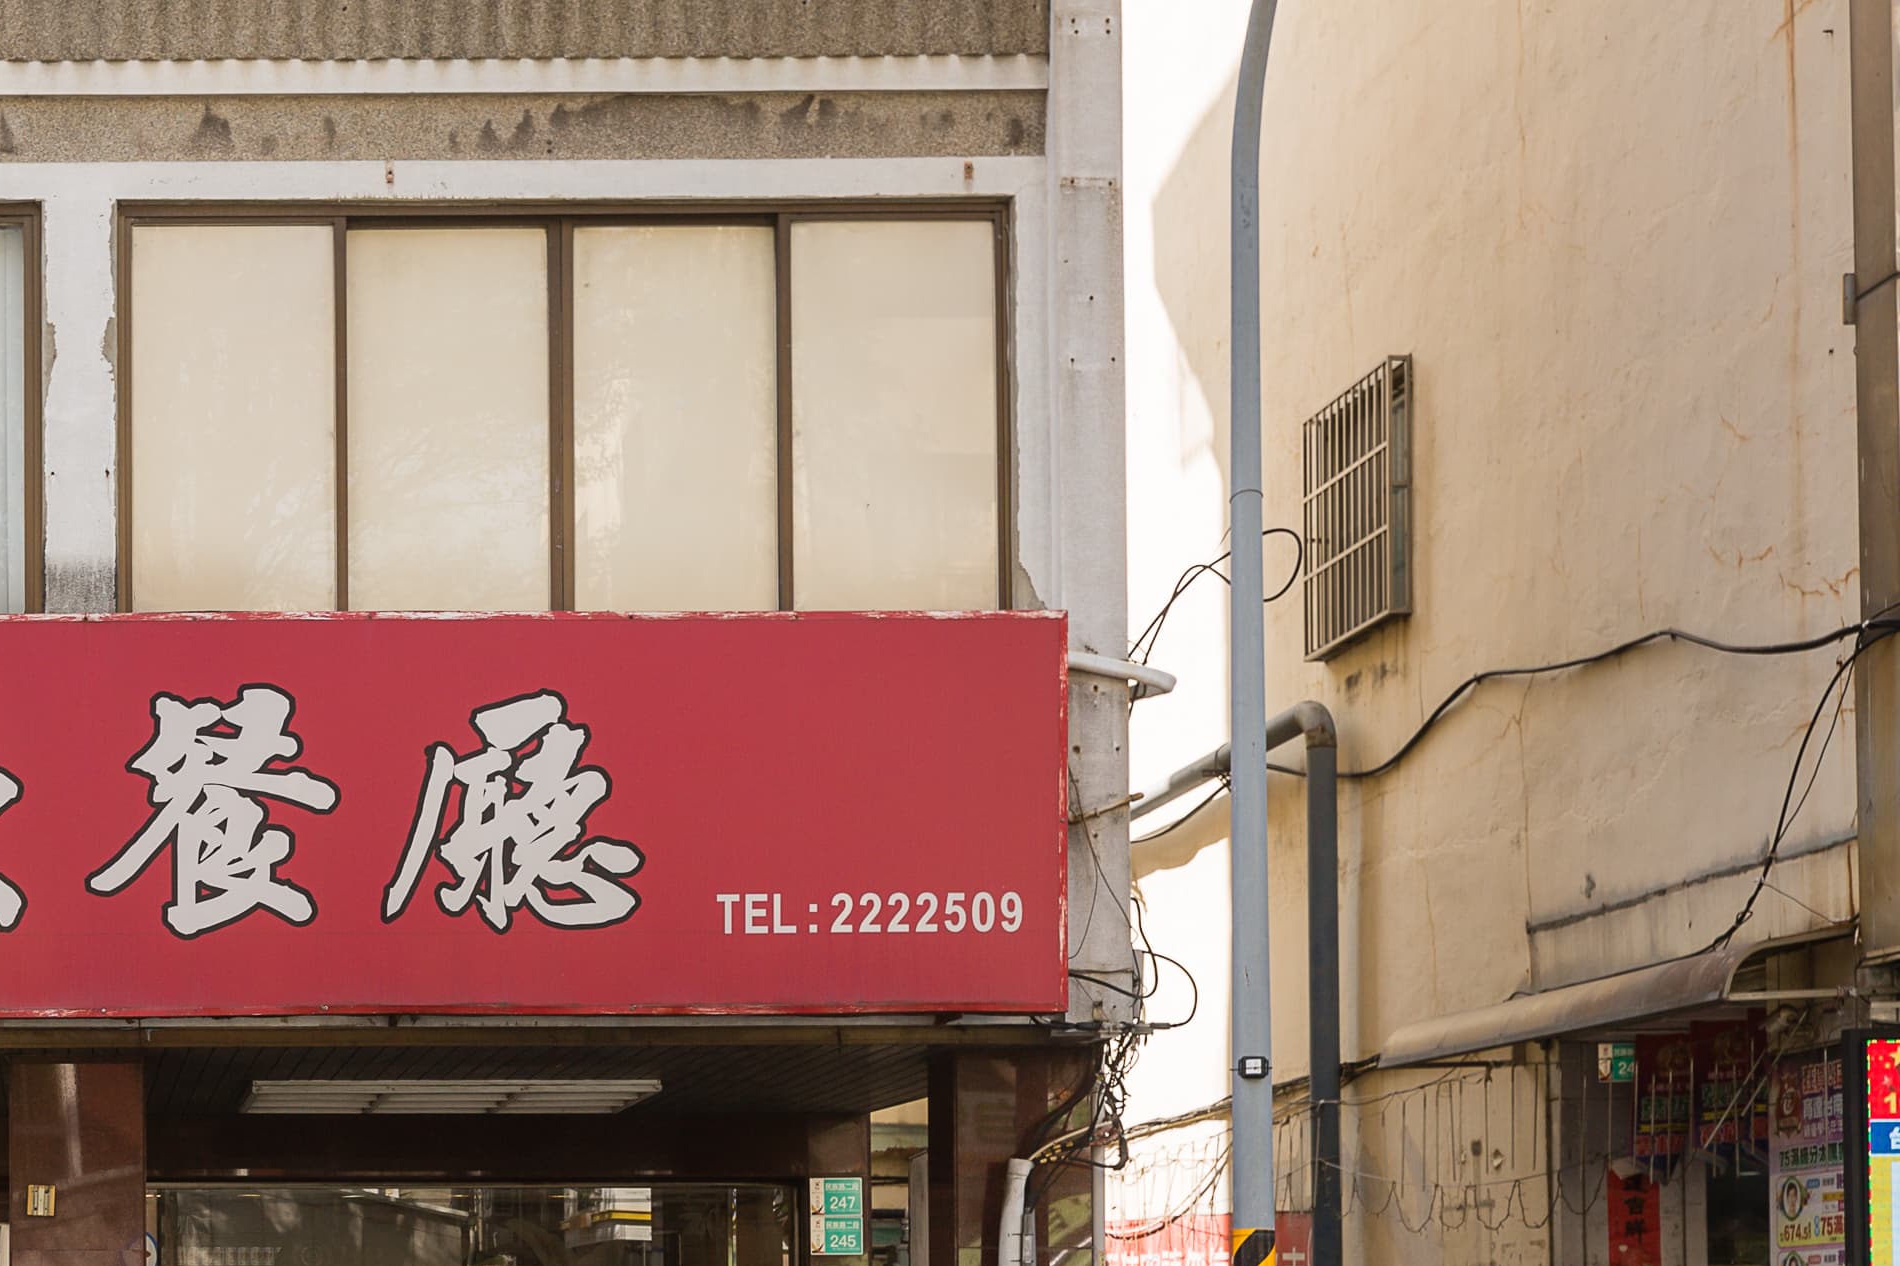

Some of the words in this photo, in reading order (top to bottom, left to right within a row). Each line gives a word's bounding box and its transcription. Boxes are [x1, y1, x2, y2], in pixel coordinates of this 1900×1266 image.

[716, 891, 1023, 934] TEL:2222509
[830, 1196, 855, 1210] 247
[830, 1234, 856, 1249] 245
